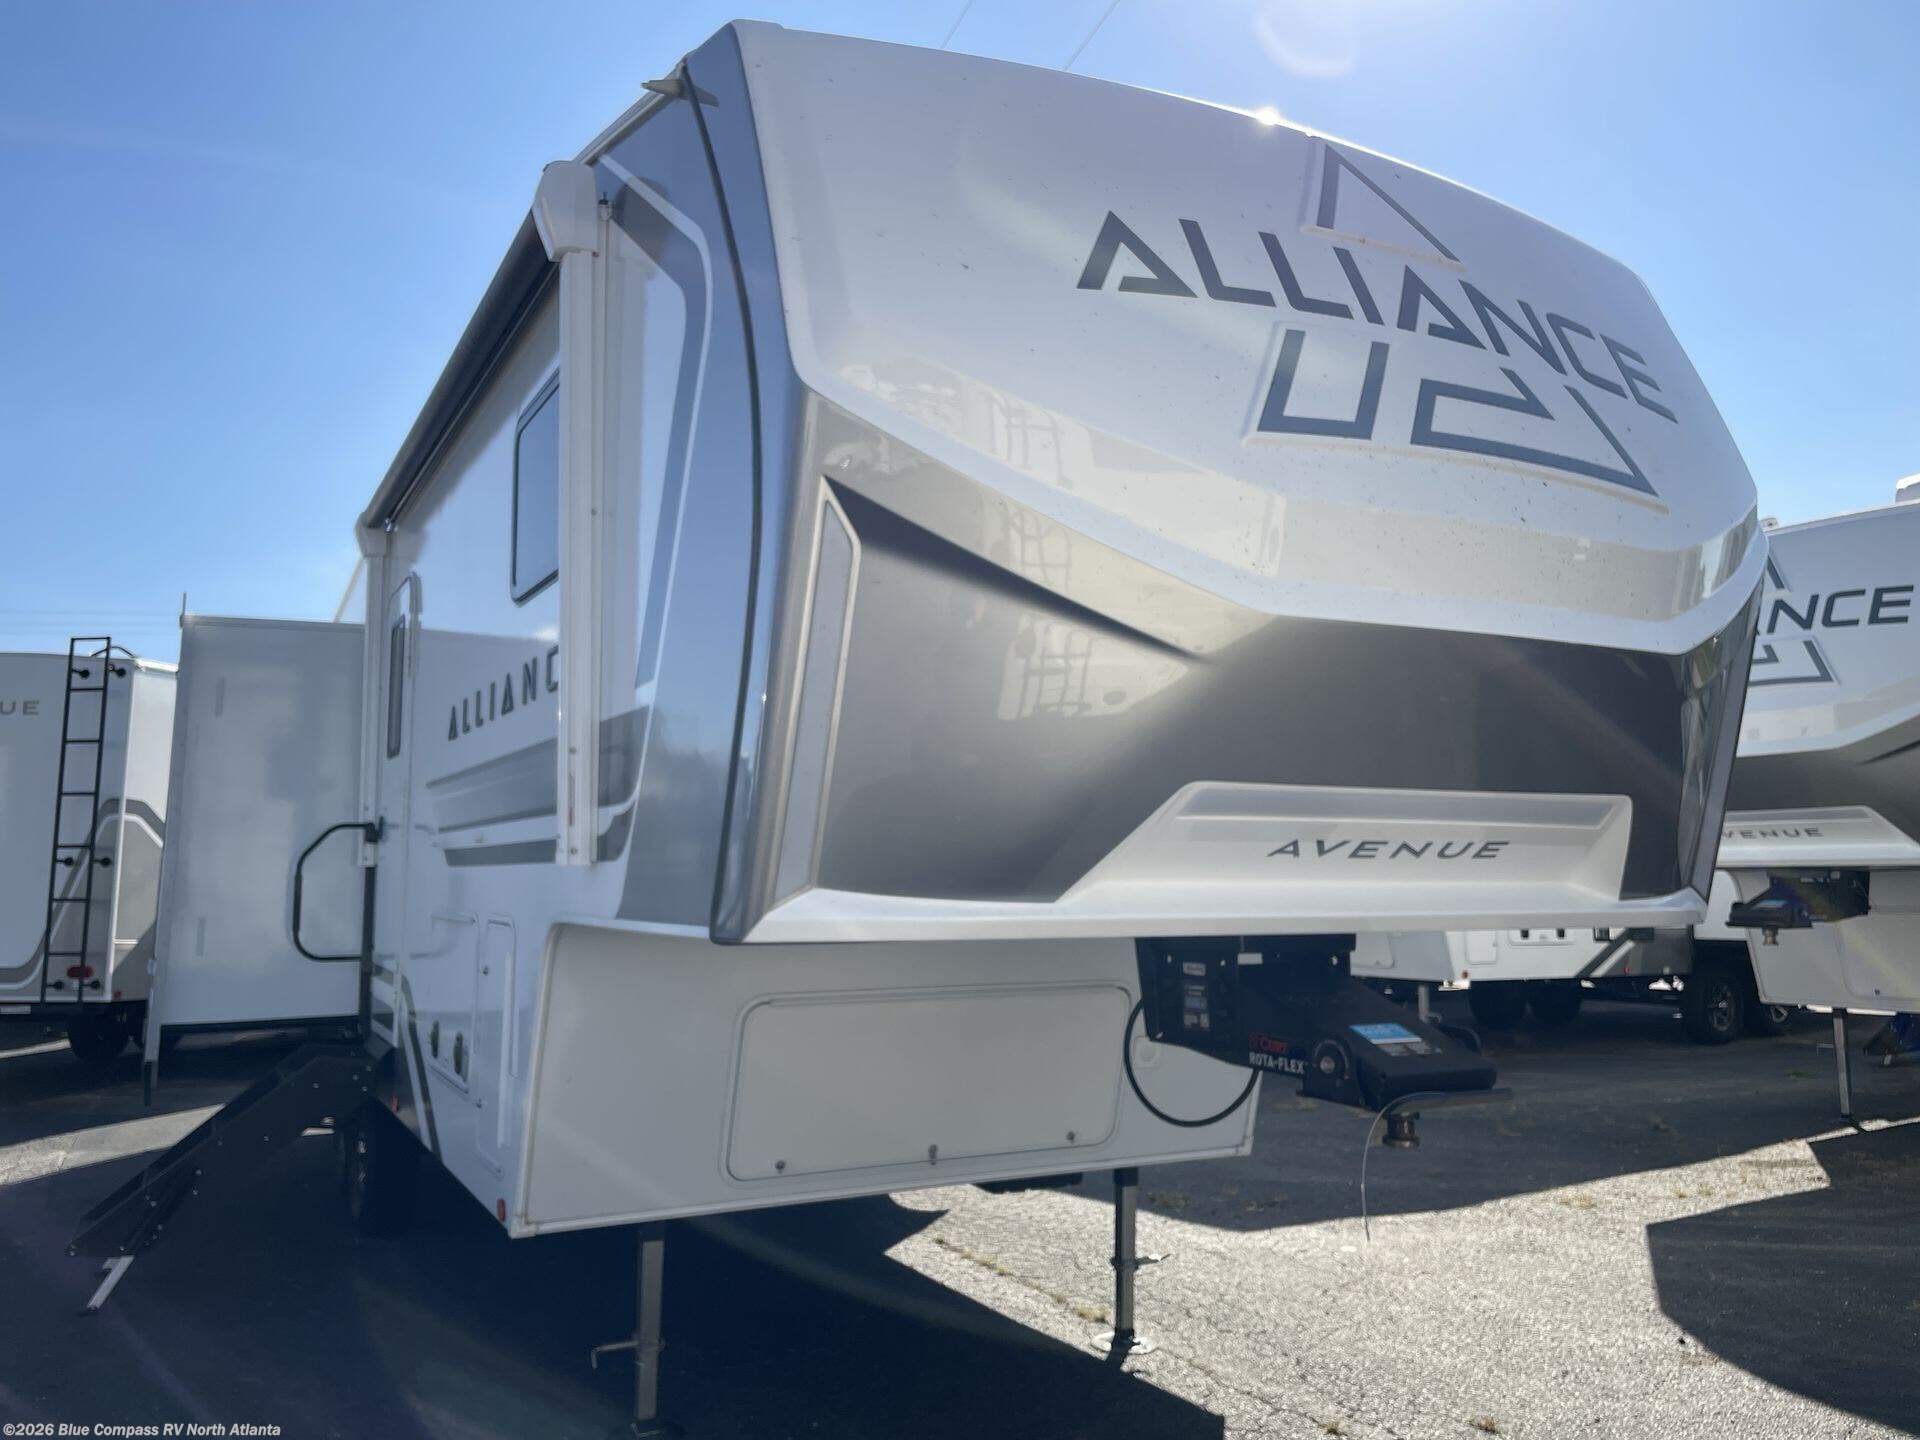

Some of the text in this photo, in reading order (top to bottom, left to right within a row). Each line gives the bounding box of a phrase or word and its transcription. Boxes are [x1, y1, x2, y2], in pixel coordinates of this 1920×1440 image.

[1076, 209, 1679, 425] ALLIANCE
[1757, 584, 1915, 635] NCE
[447, 644, 559, 741] ALLIANC
[1266, 838, 1511, 860] AVENUE
